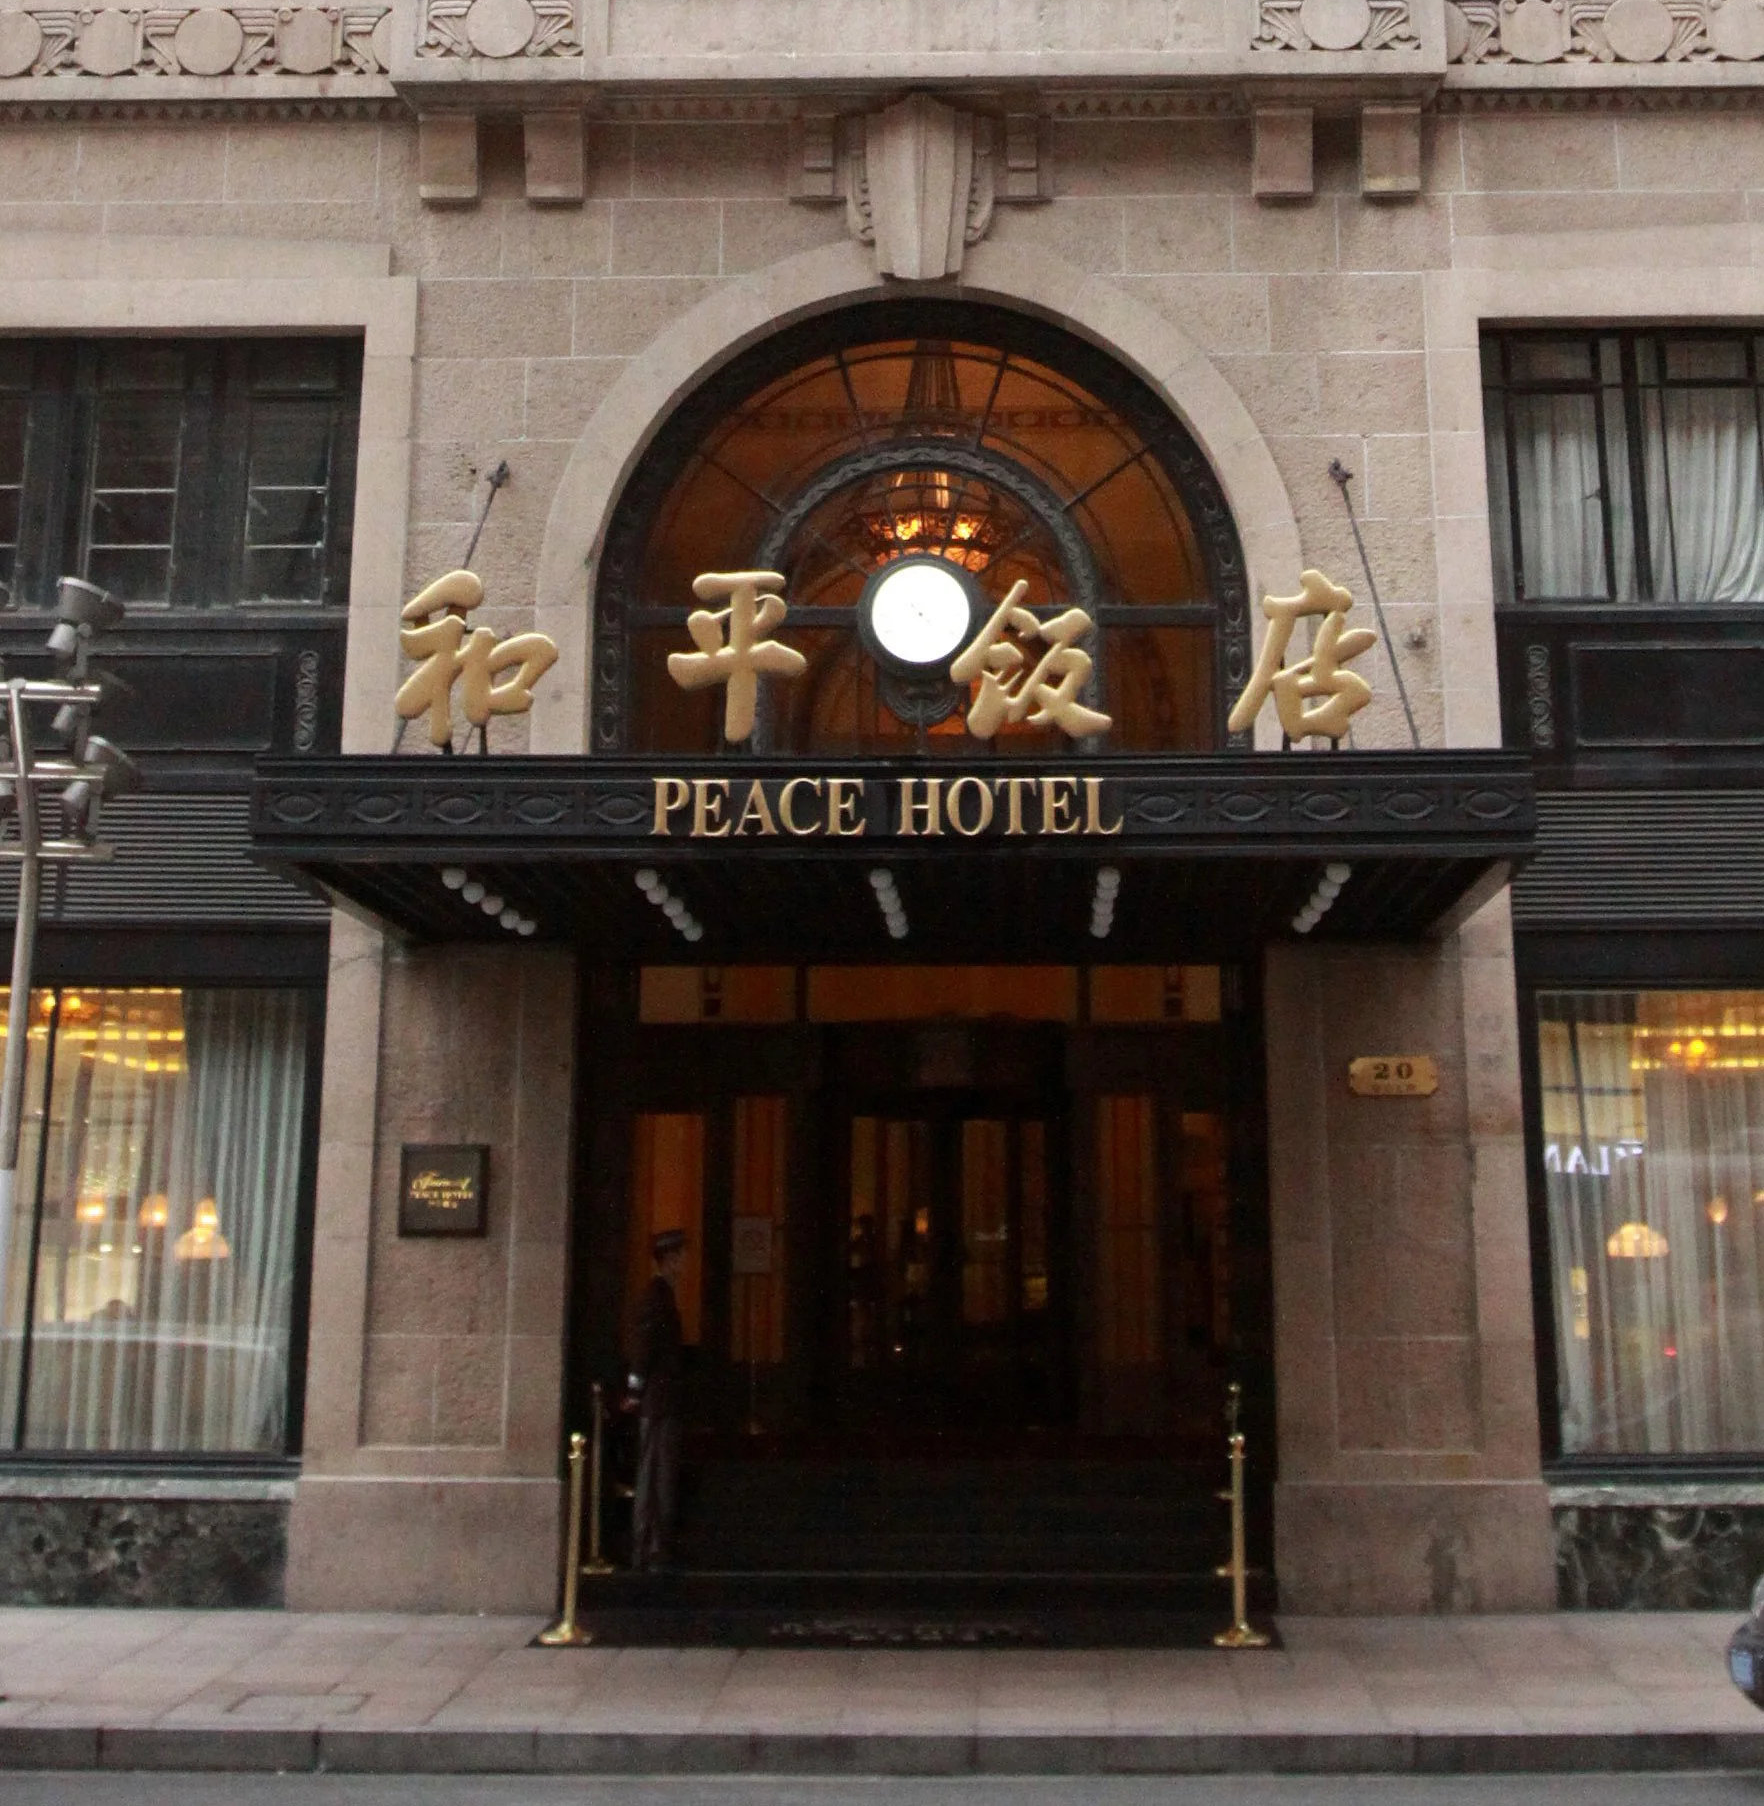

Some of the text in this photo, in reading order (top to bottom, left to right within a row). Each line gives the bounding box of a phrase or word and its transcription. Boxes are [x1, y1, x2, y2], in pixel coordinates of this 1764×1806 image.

[651, 776, 1124, 837] PEACE HOTEL
[1372, 1062, 1414, 1080] 20
